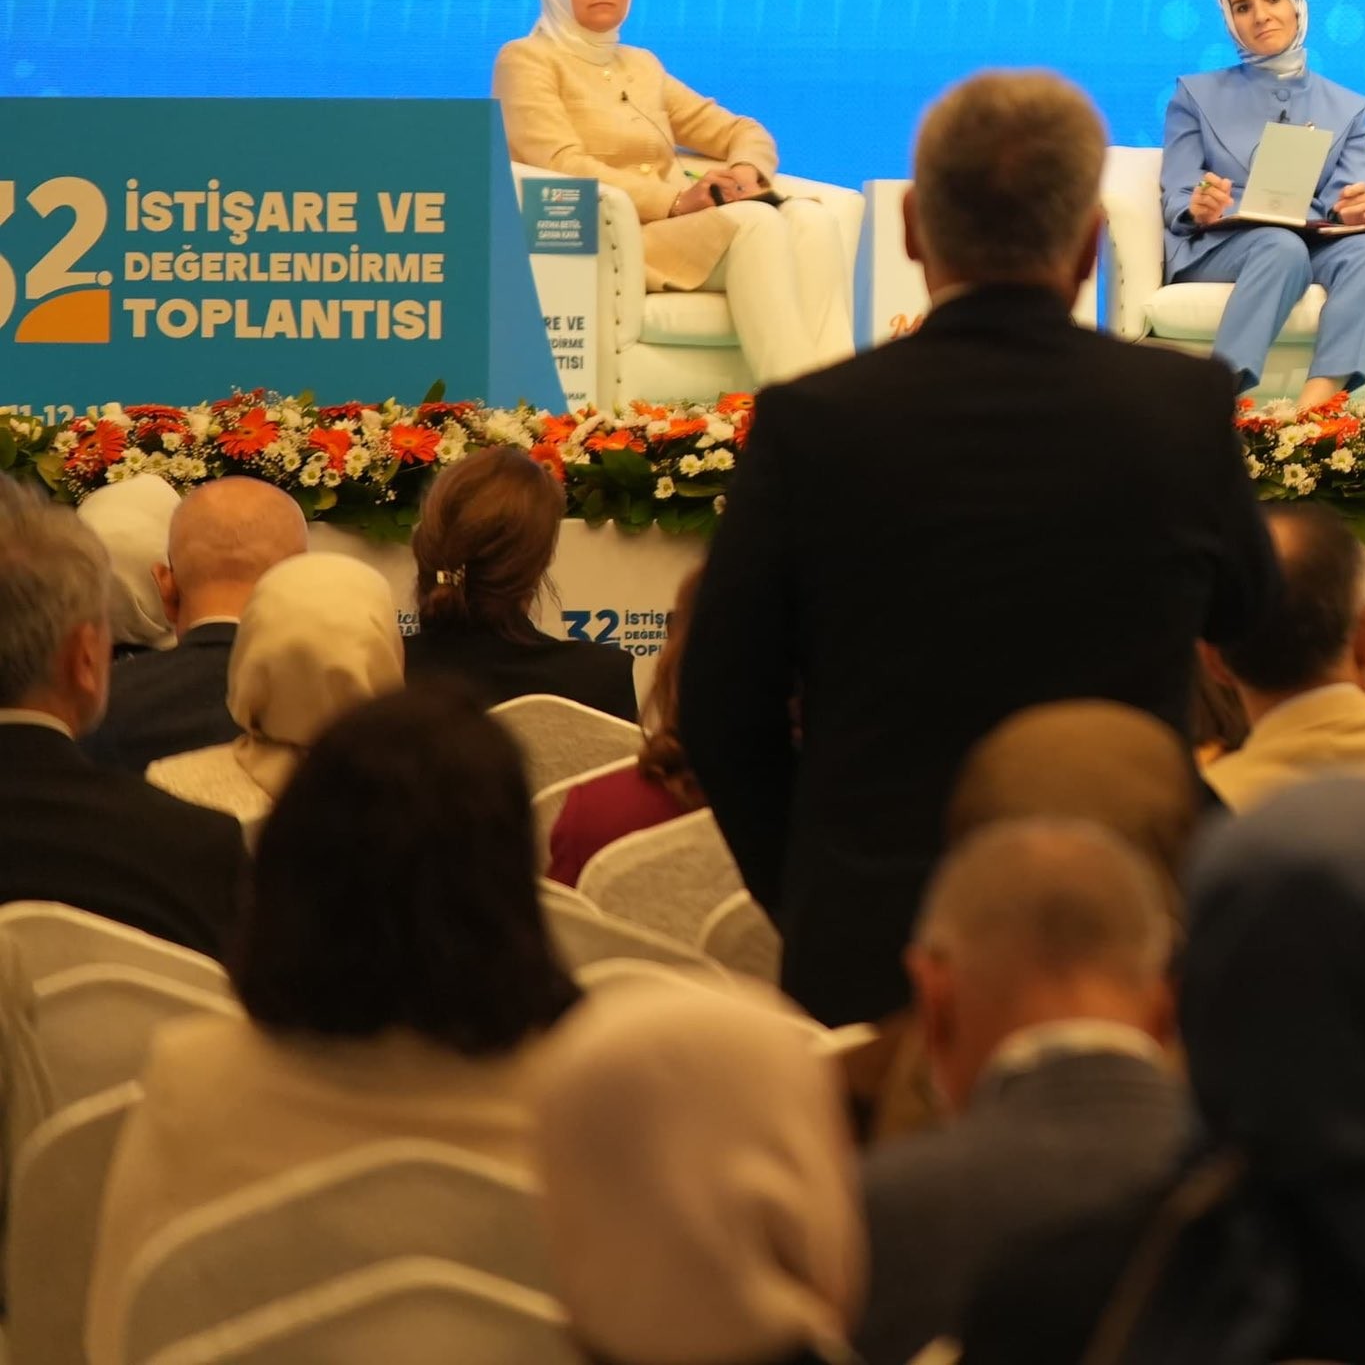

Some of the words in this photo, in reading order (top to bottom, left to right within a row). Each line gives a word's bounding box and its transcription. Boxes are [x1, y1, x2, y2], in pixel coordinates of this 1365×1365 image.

[125, 178, 358, 245] İSTİŞARE
[378, 191, 446, 233] VE
[124, 244, 445, 283] DEĞERLENDİRME
[123, 298, 442, 340] TOPLANTISI
[567, 316, 585, 330] VE
